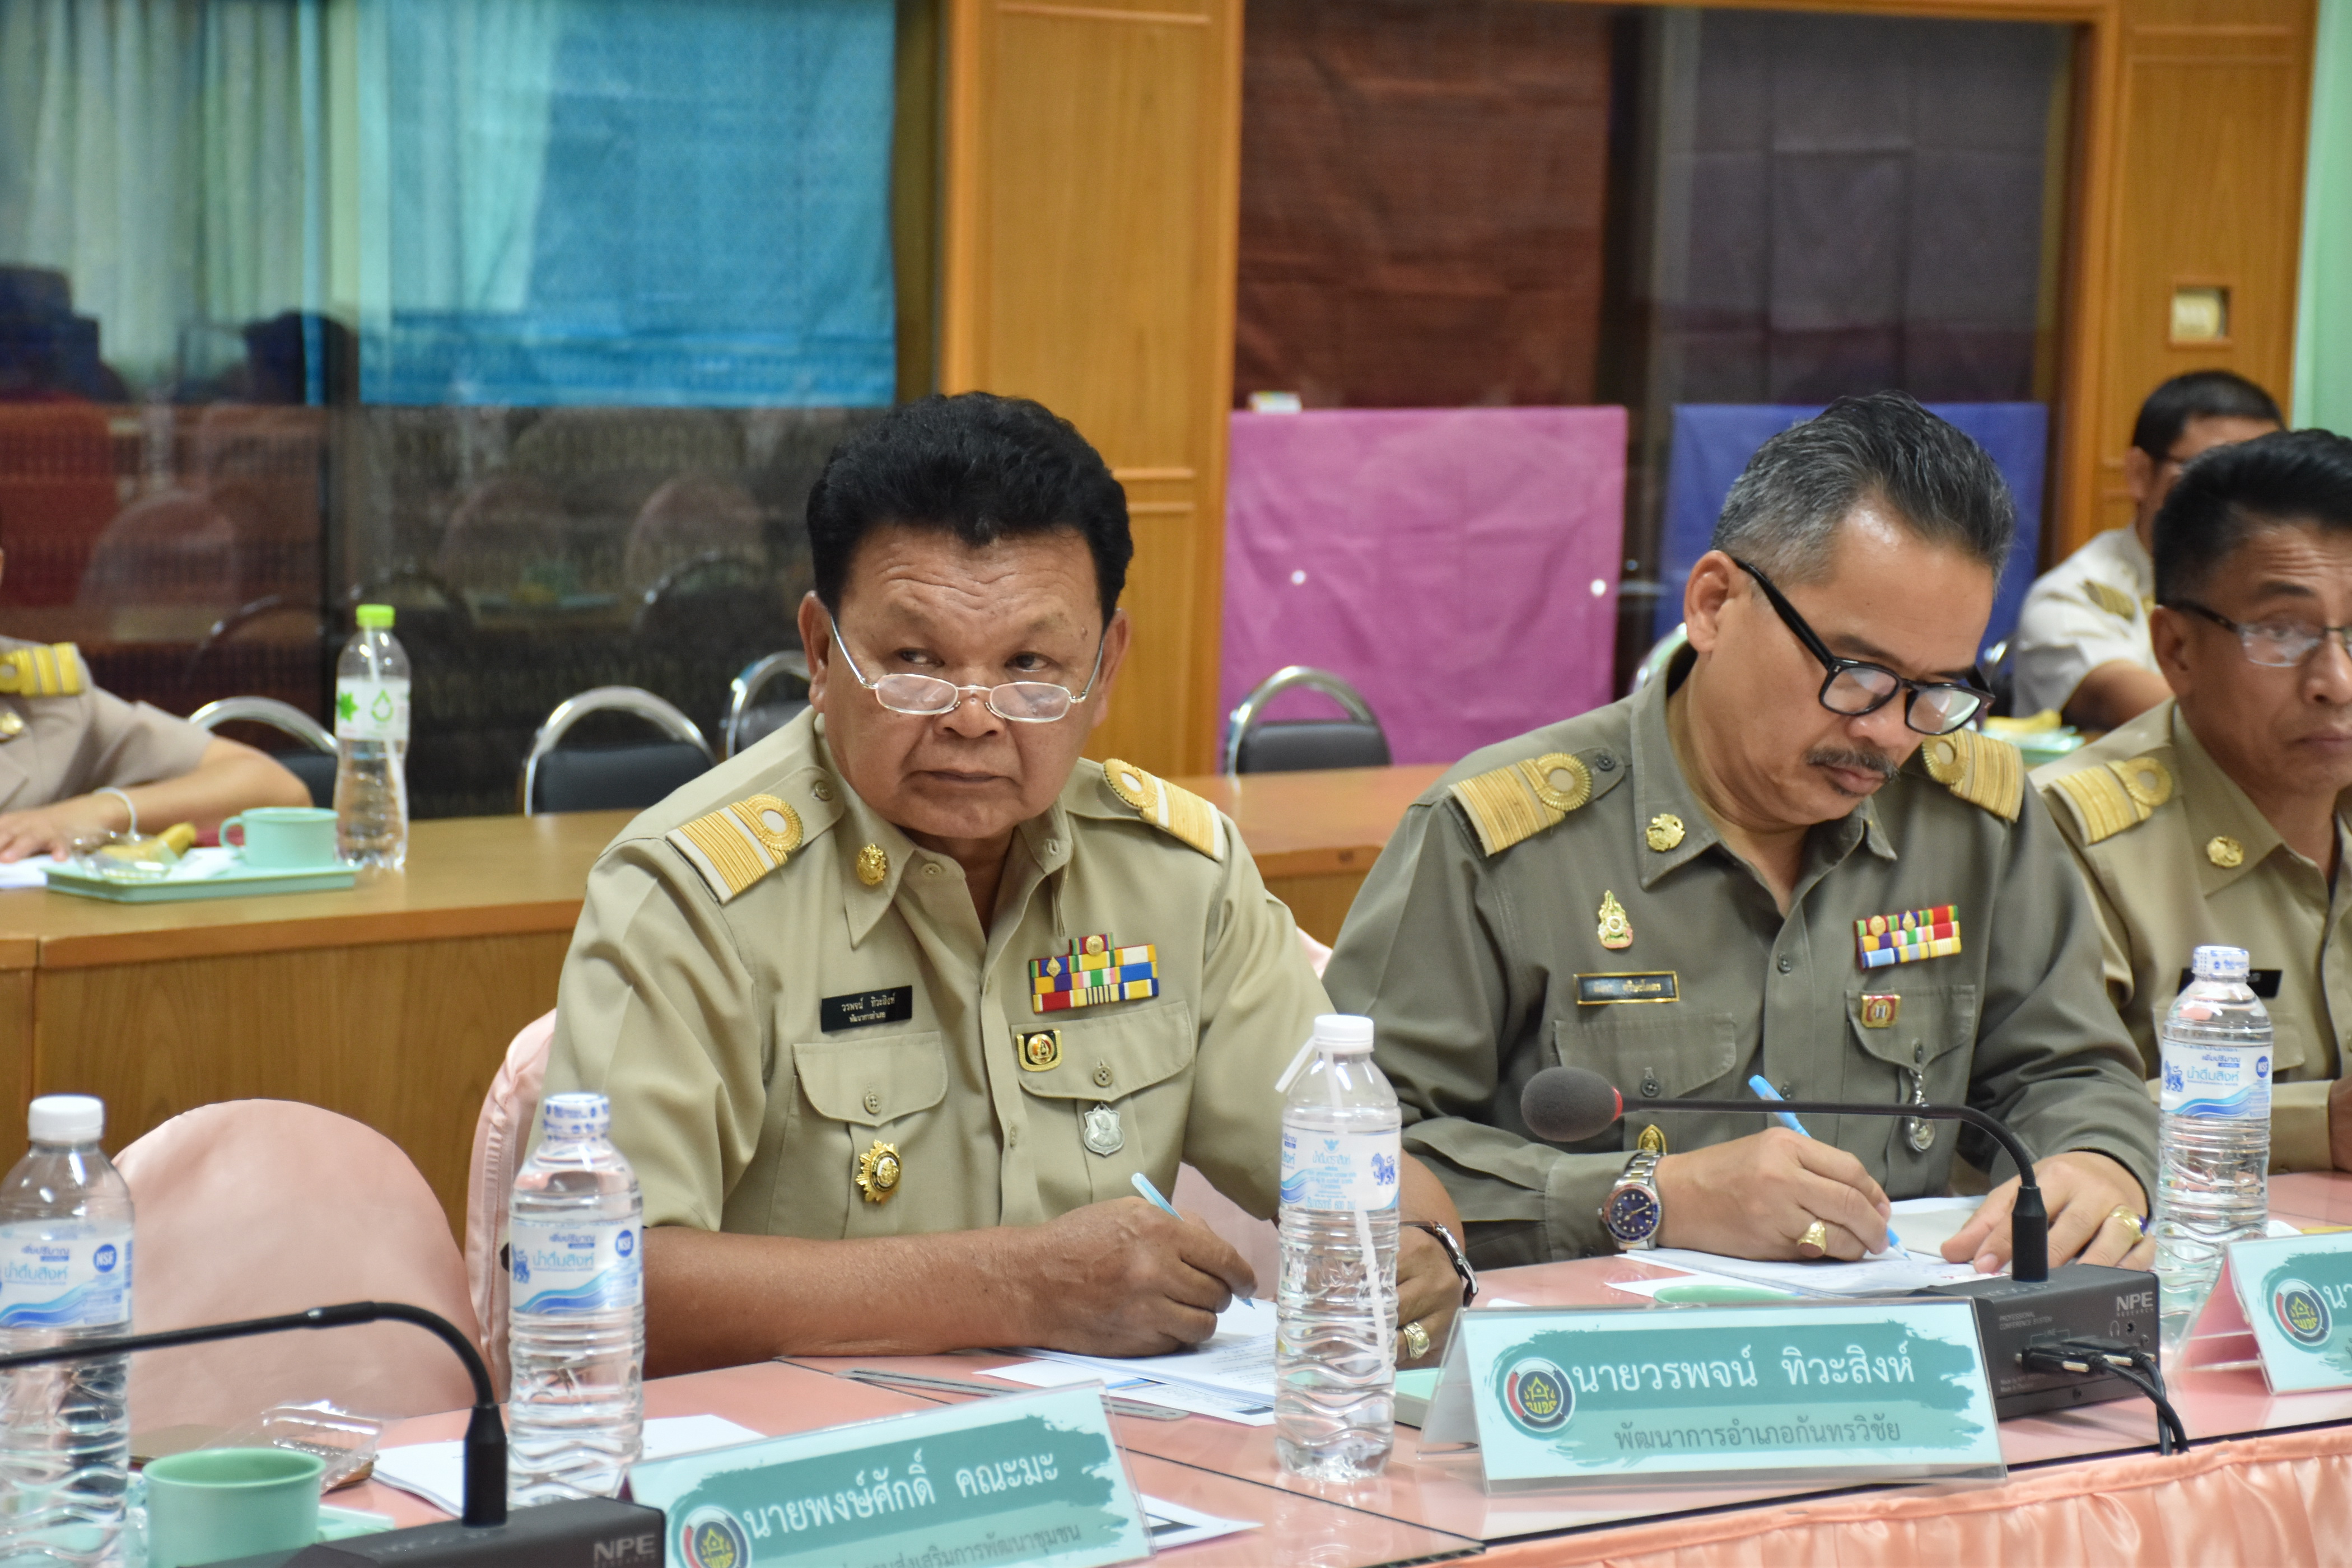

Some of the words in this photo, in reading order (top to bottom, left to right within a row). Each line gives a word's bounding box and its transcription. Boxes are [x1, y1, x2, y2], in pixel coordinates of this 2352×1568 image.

[2117, 1291, 2153, 1311] NPE
[1572, 1344, 1758, 1392] นายวรพจน์
[1781, 1340, 1915, 1385] ทิวะสิงห์
[1614, 1412, 1901, 1450] พัฒนาการอำเภอกันทรวิชัย
[743, 1447, 936, 1539] นายพงษ์ศักดิ์
[955, 1453, 1058, 1498] คณะมะ
[594, 1533, 656, 1562] NPE
